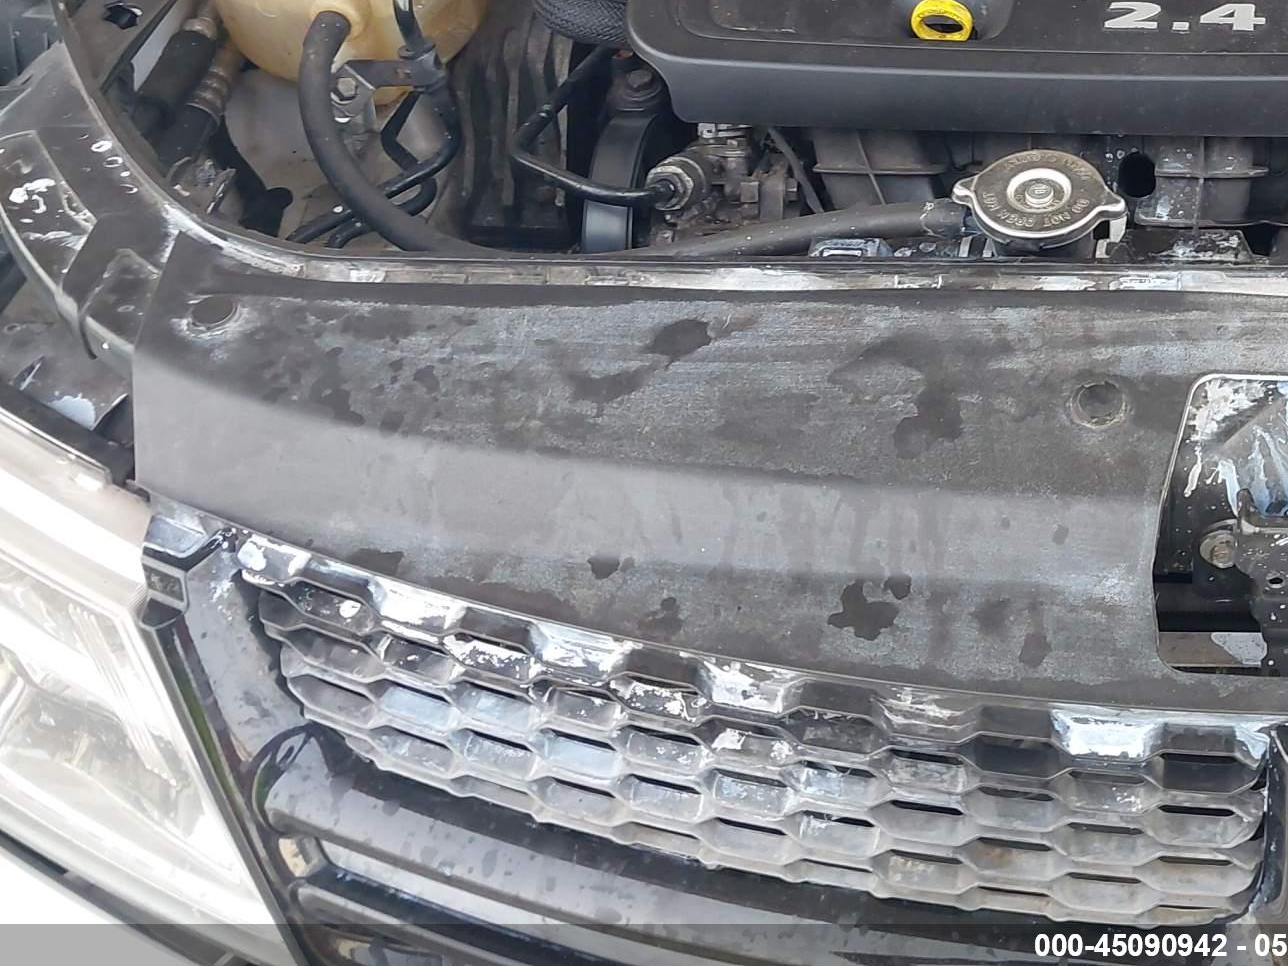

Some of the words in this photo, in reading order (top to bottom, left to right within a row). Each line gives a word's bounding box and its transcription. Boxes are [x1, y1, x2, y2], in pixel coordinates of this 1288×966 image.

[1071, 198, 1090, 213] DO
[998, 209, 1035, 228] OPEN
[1043, 211, 1071, 227] NOT
